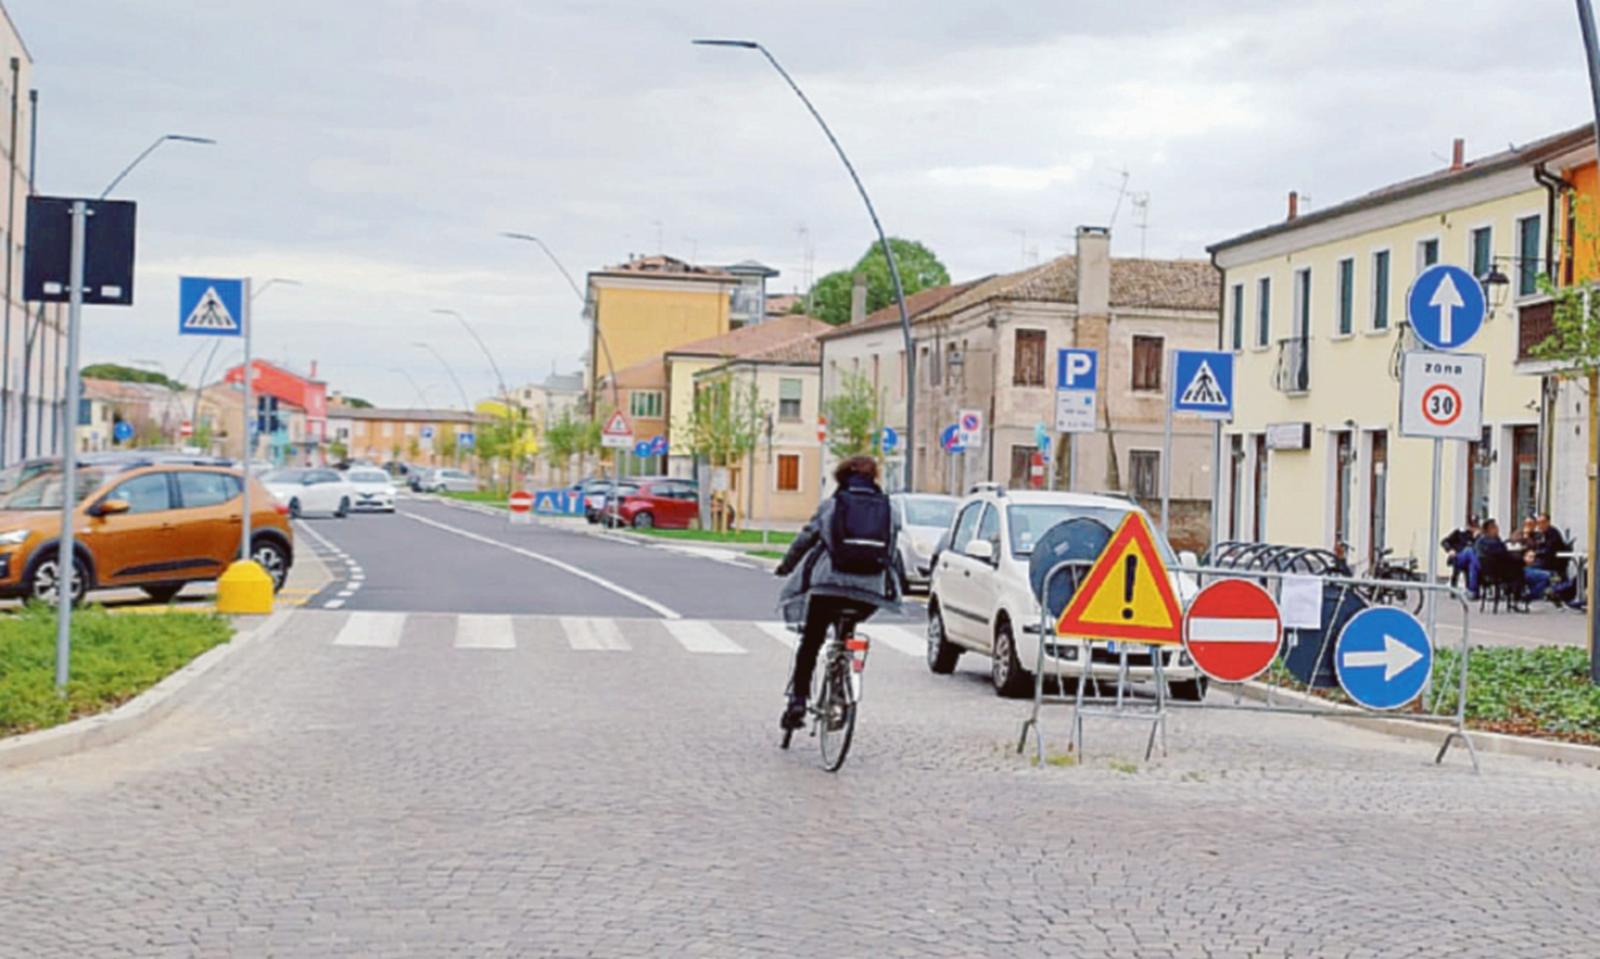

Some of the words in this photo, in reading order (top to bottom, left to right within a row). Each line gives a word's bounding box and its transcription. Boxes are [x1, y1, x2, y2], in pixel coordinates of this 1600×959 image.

[1066, 353, 1092, 385] P
[1425, 363, 1462, 374] zona
[1431, 395, 1453, 415] 30
